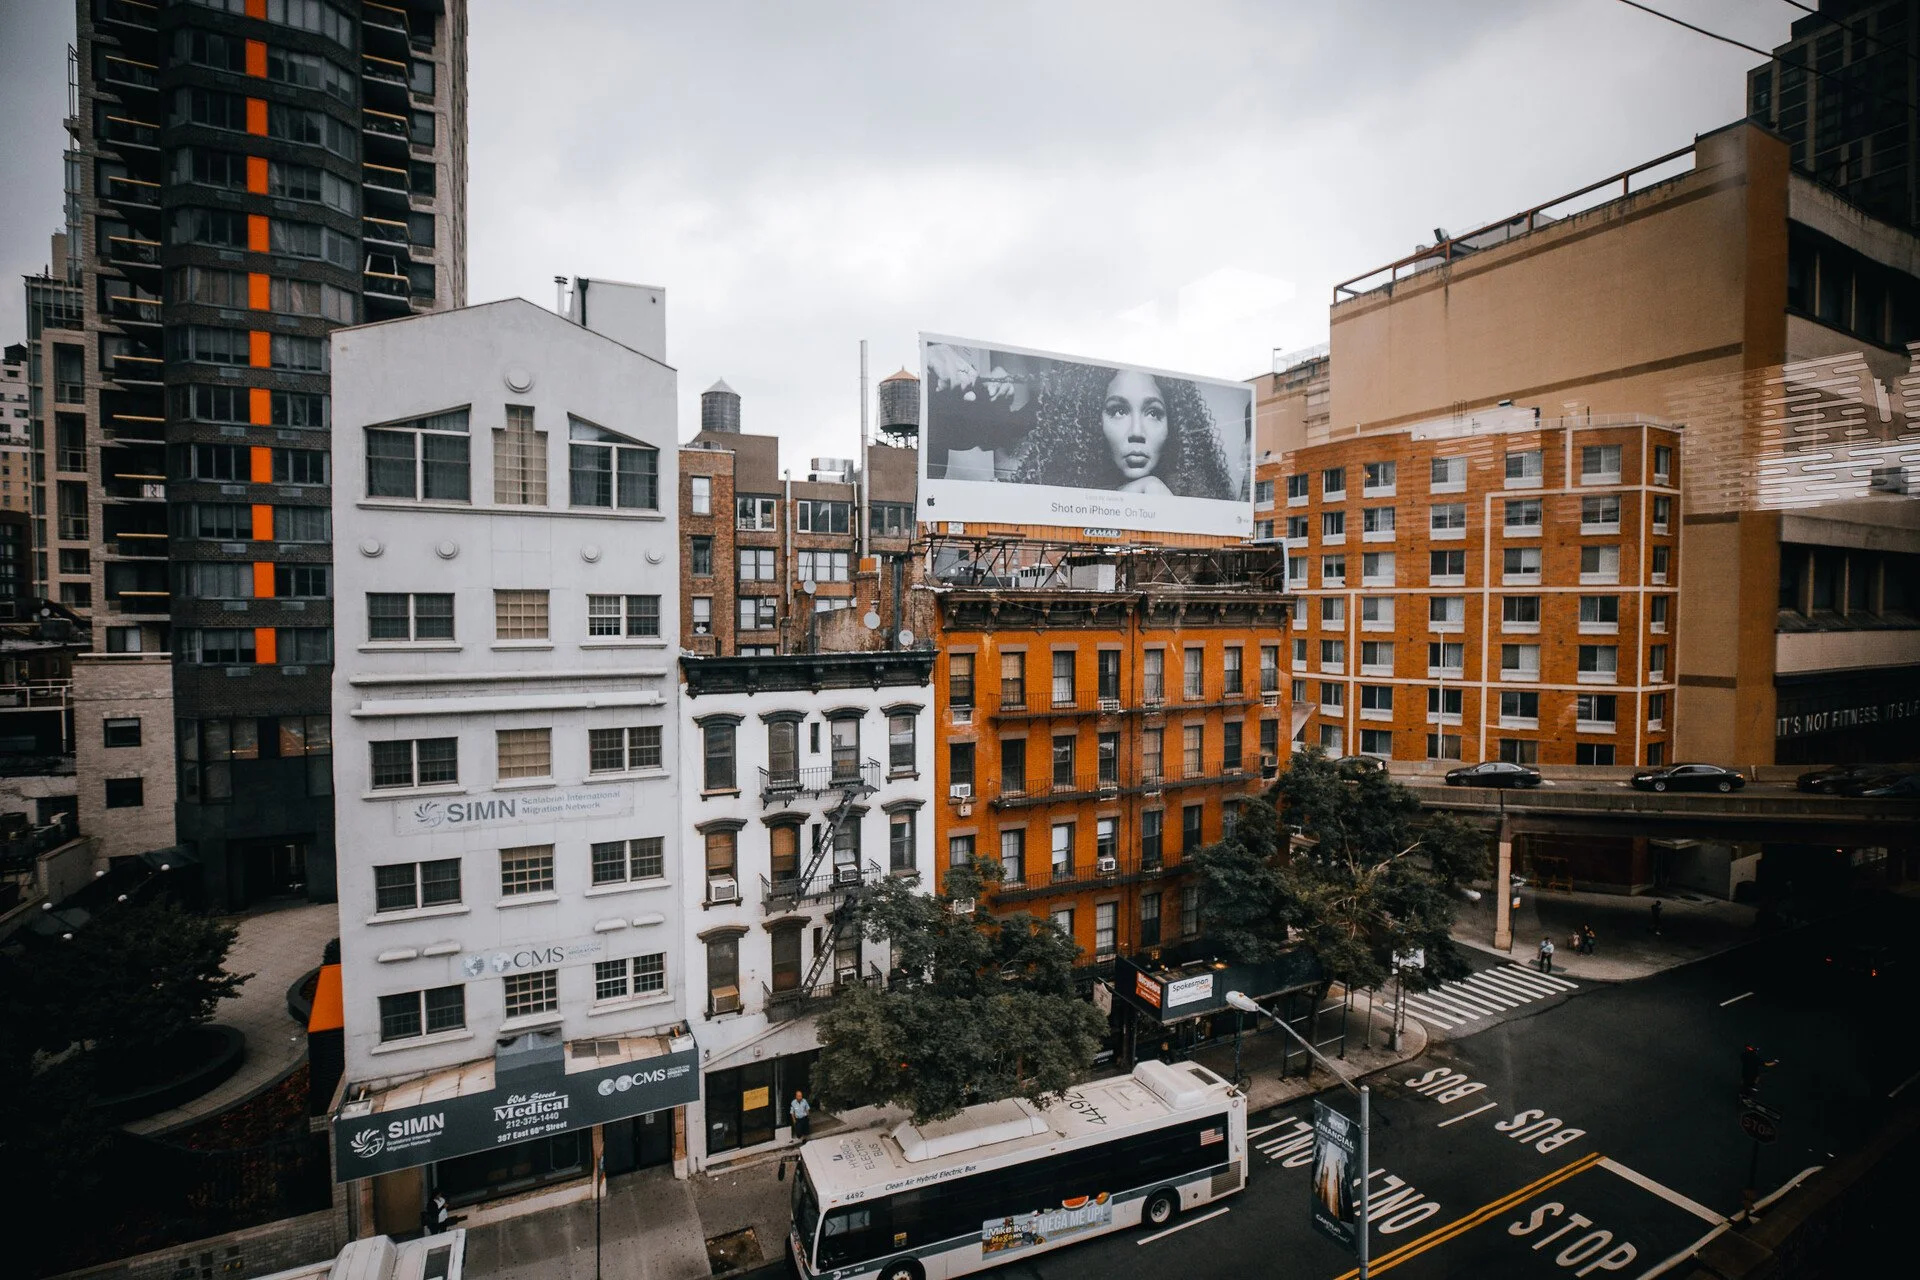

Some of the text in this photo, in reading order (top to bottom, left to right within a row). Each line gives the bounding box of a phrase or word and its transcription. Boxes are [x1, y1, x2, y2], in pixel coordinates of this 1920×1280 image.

[1051, 502, 1156, 519] Shot on iPhone On Tour
[1086, 528, 1118, 537] LAMAR
[1776, 715, 1801, 737] IT'S
[1805, 711, 1829, 732] NOT
[1887, 702, 1904, 719] IT'S
[567, 791, 620, 801] International
[447, 799, 515, 823] SIMN
[521, 801, 601, 815] Migration Network
[513, 946, 564, 968] CMS
[1172, 977, 1209, 992] Spokesman
[632, 1068, 666, 1086] CMS
[1404, 1067, 1487, 1105] BUS
[507, 1091, 556, 1105] 60th Street
[494, 1097, 569, 1121] Medical
[388, 1112, 445, 1139] SIMN
[505, 1111, 559, 1129] 212-375-1440
[513, 1129, 529, 1139] East
[545, 1121, 567, 1132] Street
[1742, 1116, 1775, 1136] STOP
[1315, 1120, 1355, 1150] FINANCIAL
[1494, 1108, 1587, 1154] BUS
[869, 1143, 883, 1157] BUS
[885, 1164, 976, 1191] Clean Air Hybrid Electric Bus
[845, 1191, 864, 1201] 4492
[1038, 1213, 1068, 1234] MEGA
[1070, 1211, 1085, 1227] ME
[1507, 1202, 1638, 1278] STOP
